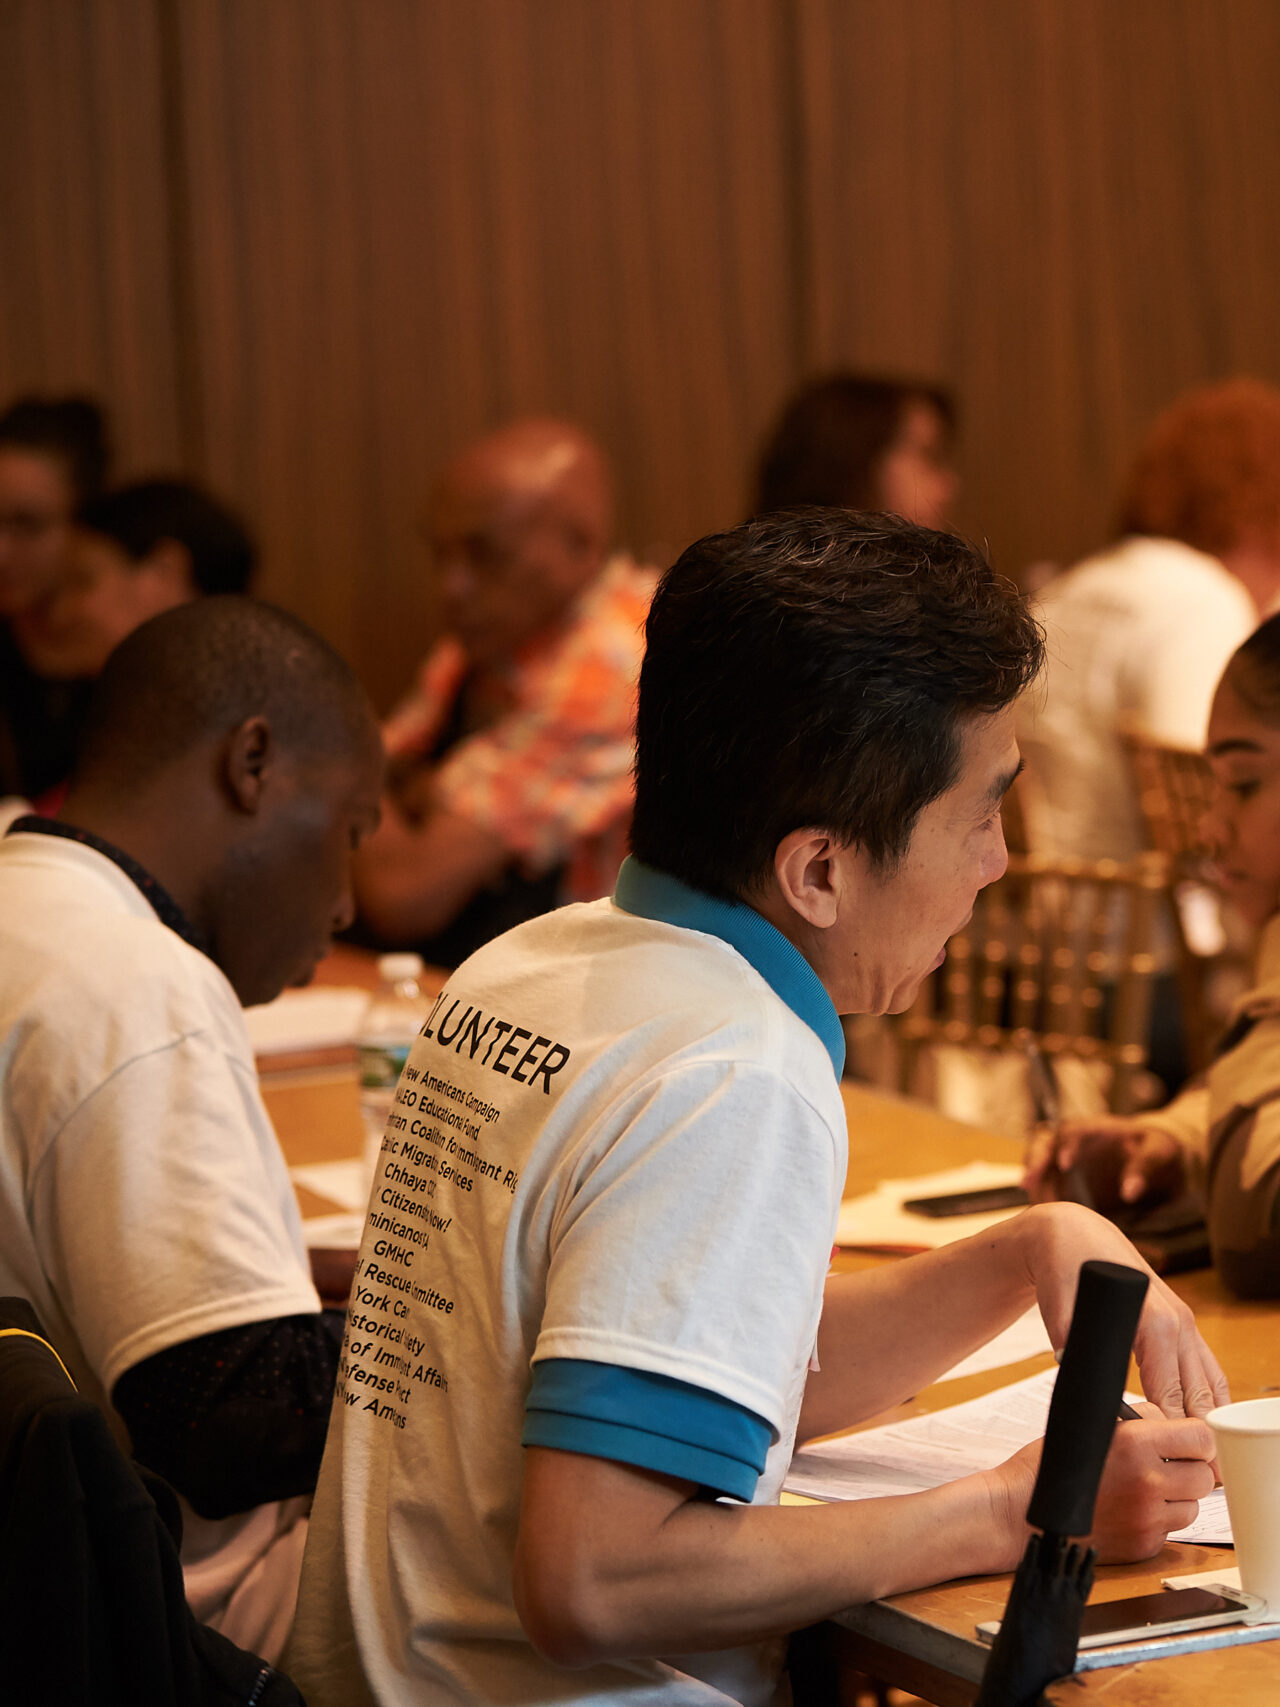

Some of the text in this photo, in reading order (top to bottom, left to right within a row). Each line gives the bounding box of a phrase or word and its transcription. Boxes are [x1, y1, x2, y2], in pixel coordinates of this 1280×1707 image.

[419, 992, 571, 1095] LUNTEER
[420, 1071, 466, 1104] Americans
[385, 1162, 427, 1192] Chhaya
[374, 1240, 414, 1267] GMHC
[364, 1263, 412, 1293] Rescue
[355, 1285, 392, 1312] York
[350, 1341, 373, 1357] of
